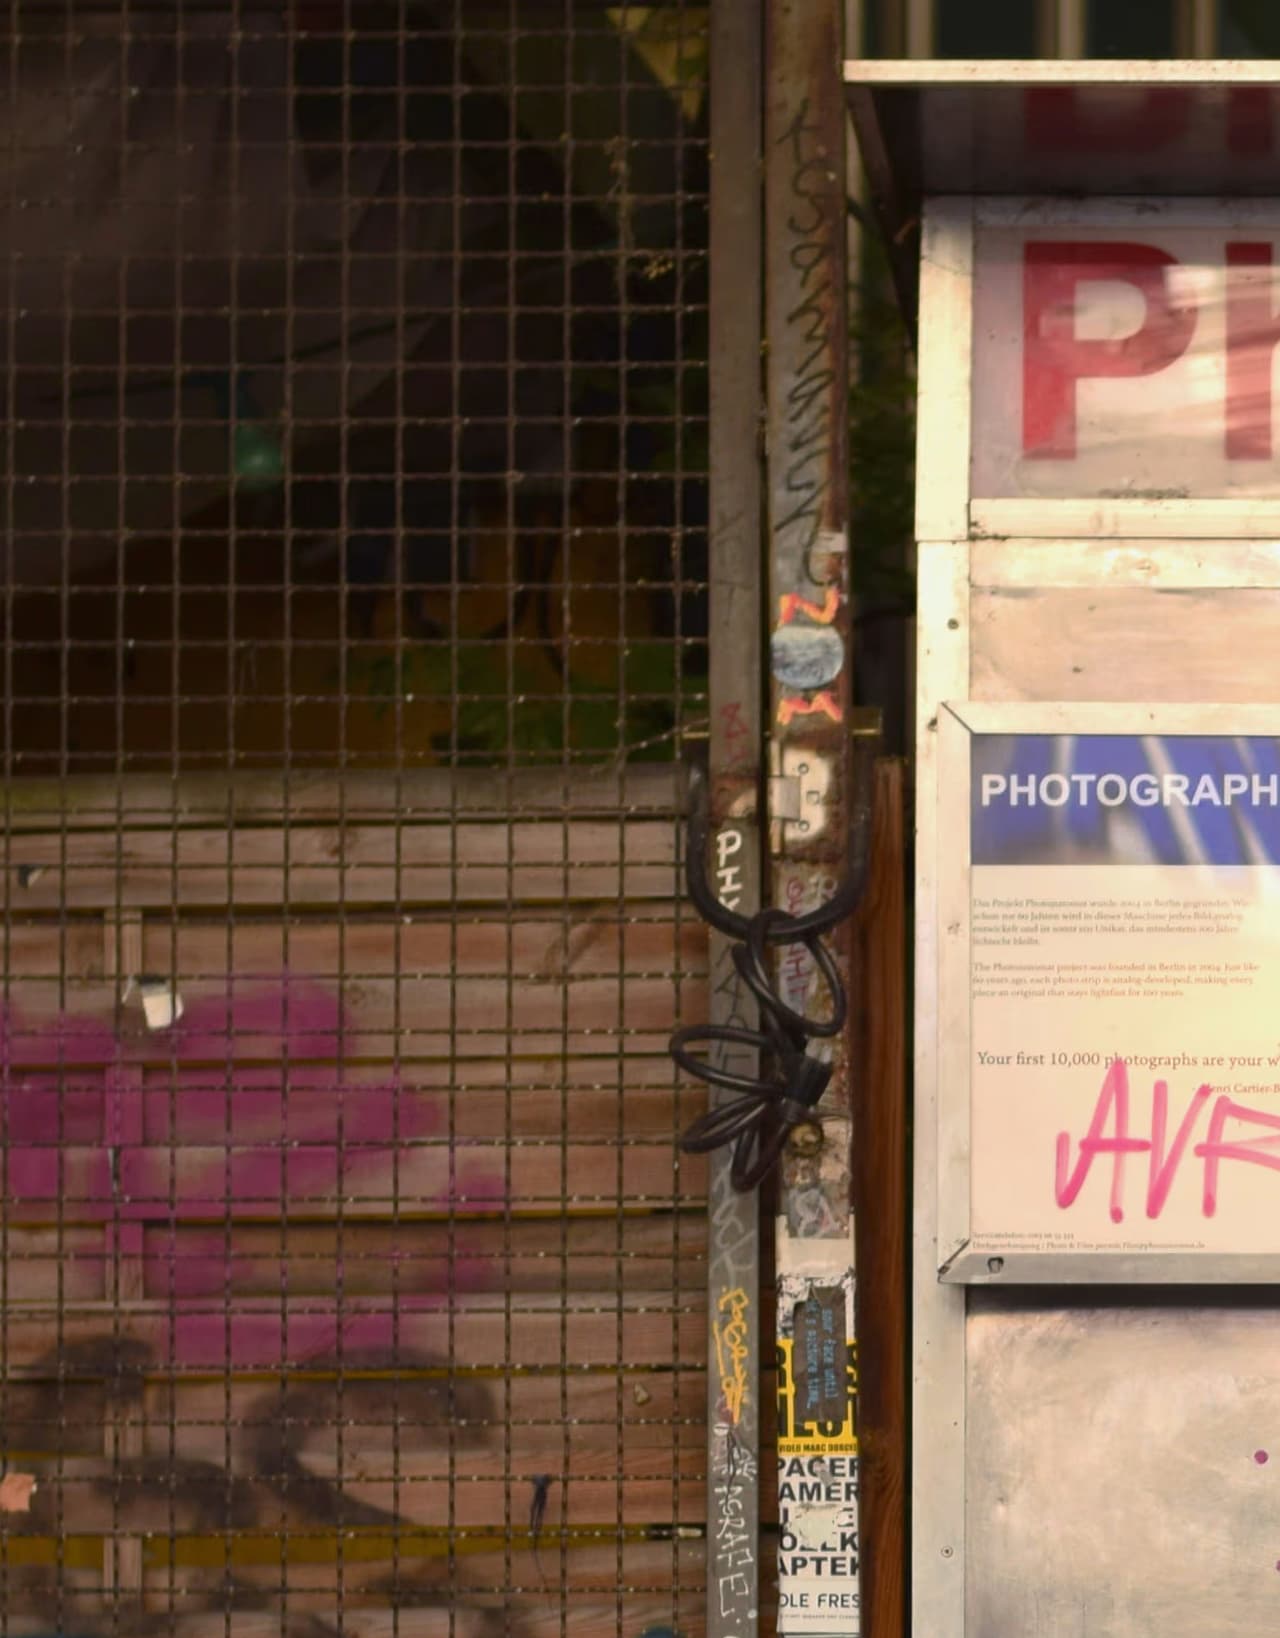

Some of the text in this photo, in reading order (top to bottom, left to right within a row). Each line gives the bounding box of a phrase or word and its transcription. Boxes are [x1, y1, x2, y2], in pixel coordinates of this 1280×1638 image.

[977, 1052, 1012, 1066] Your
[1016, 1052, 1045, 1065] first
[1050, 1053, 1100, 1068] 10,000
[1104, 1053, 1198, 1070] photographs
[1202, 1057, 1224, 1067] are
[1229, 1057, 1263, 1070] your
